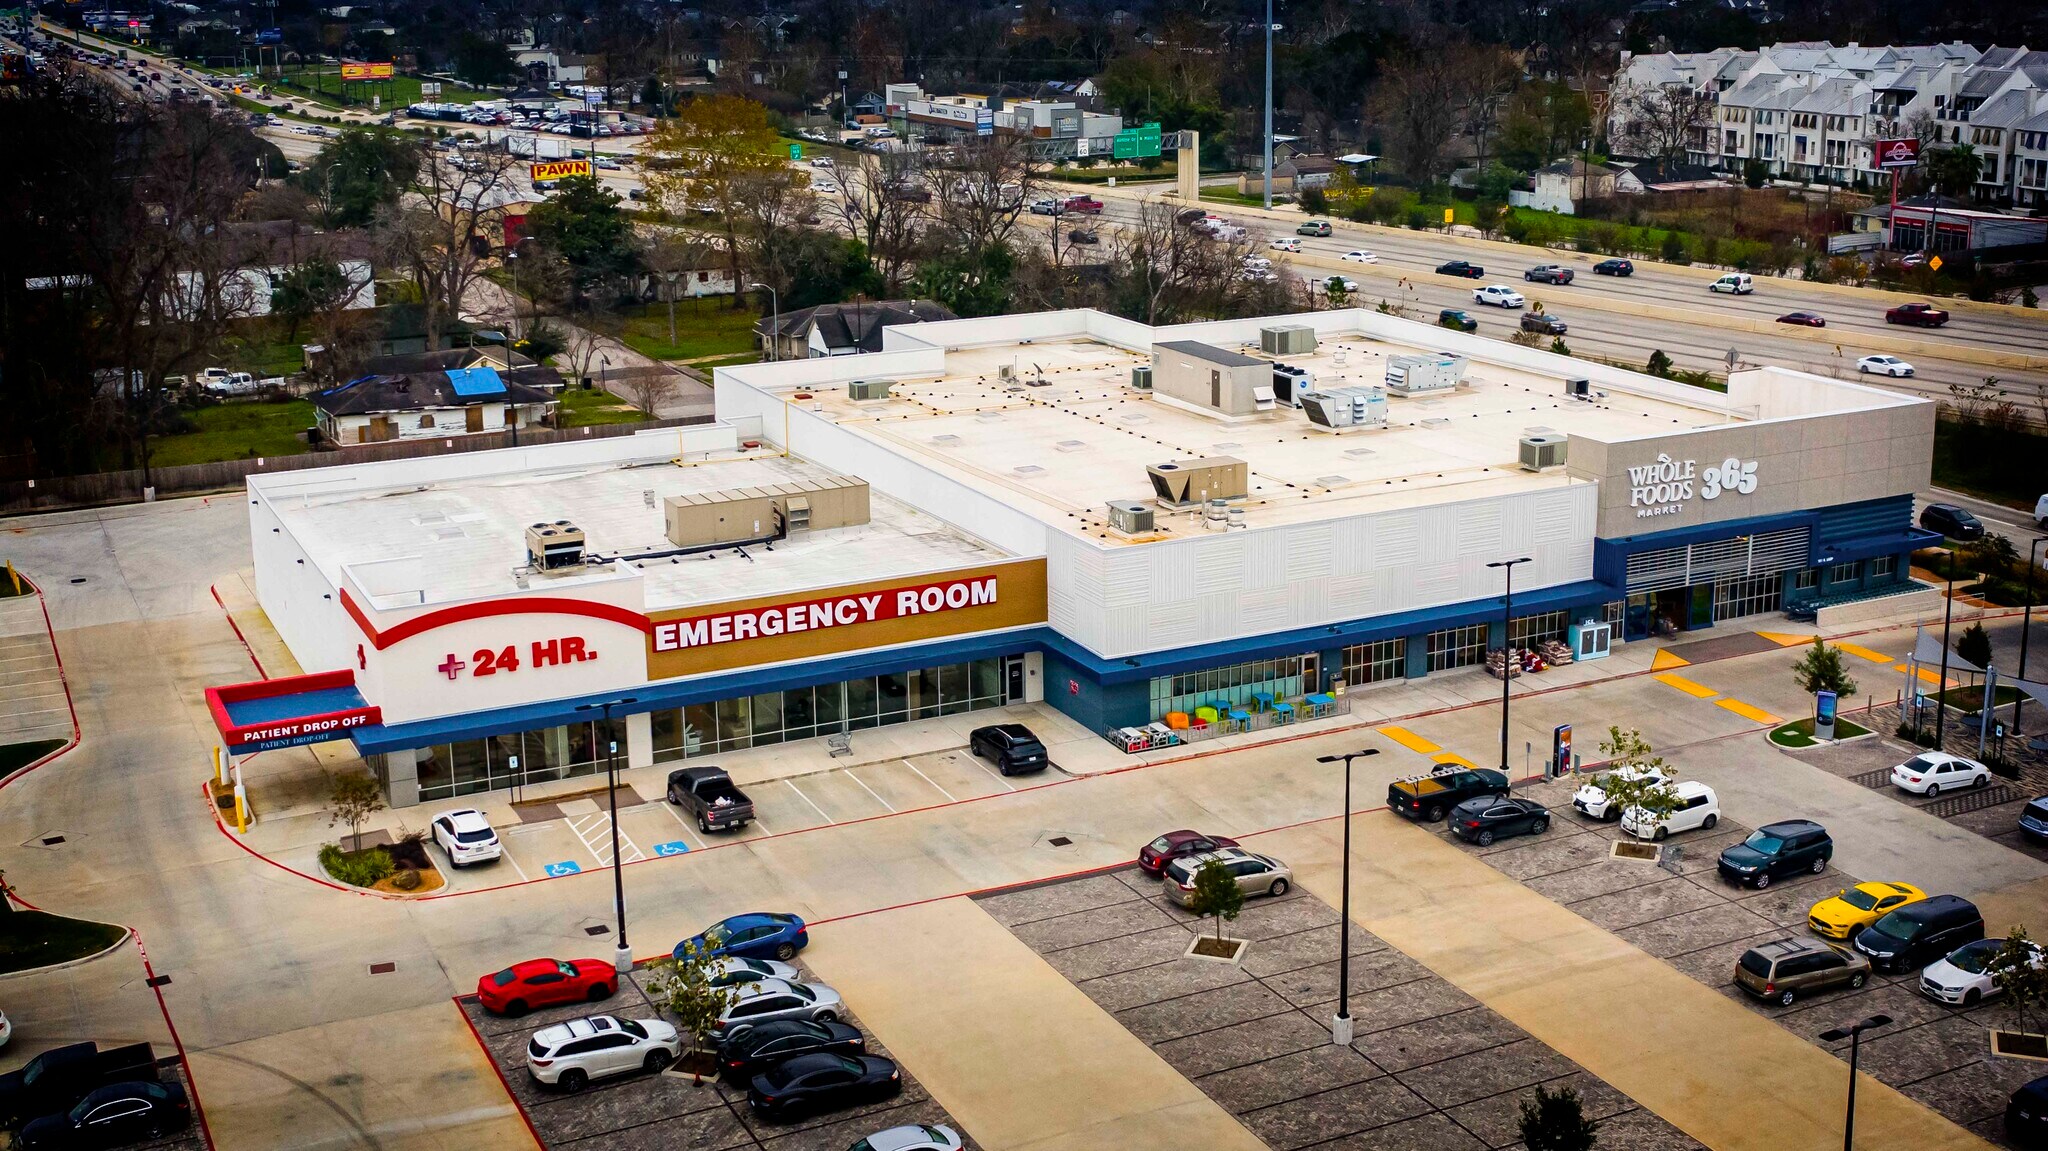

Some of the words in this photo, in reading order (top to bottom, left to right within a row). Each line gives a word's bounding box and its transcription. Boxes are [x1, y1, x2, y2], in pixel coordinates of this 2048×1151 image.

[536, 162, 587, 177] PAWN
[1627, 455, 1696, 487] WHOLE
[1700, 457, 1759, 500] 365
[1630, 480, 1694, 507] FOODS
[1636, 504, 1683, 518] MARKET
[655, 594, 883, 651] EMERGENCY
[896, 578, 997, 617] ROOM
[472, 645, 520, 677] 24
[531, 636, 598, 668] HR.
[243, 725, 300, 742] PATIENT
[302, 719, 339, 733] DROP
[341, 715, 367, 727] OFF
[260, 739, 290, 749] PATIENT
